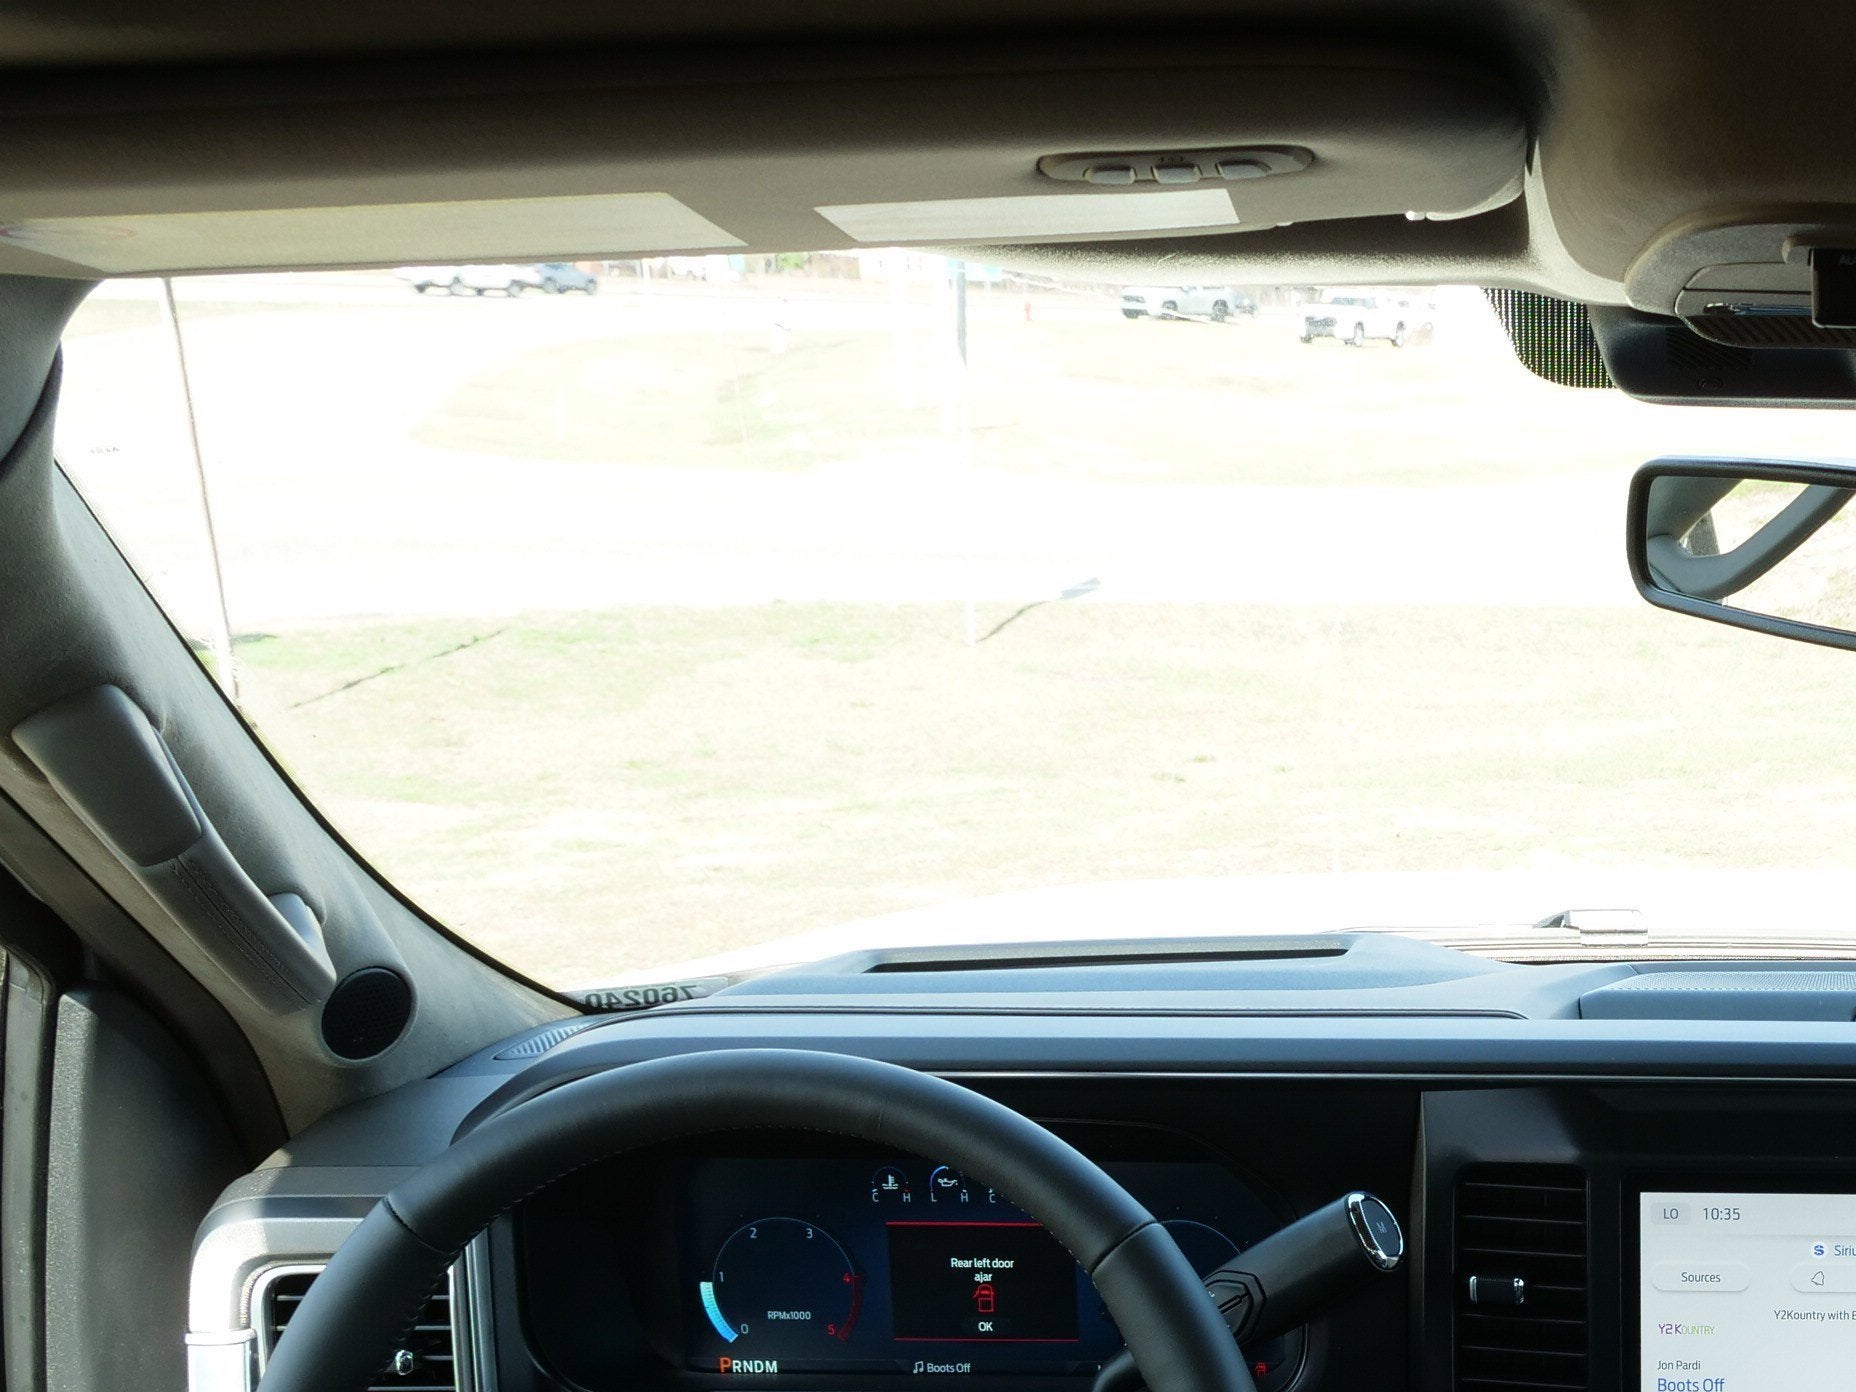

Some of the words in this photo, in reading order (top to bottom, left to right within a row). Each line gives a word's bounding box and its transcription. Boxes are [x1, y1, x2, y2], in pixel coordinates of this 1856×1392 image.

[1662, 1208, 1679, 1220] LO
[1702, 1207, 1741, 1222] 10:35
[750, 1228, 757, 1238] 2
[807, 1228, 813, 1238] 3
[951, 1258, 972, 1268] Rear
[974, 1258, 991, 1268] left
[992, 1258, 1014, 1268] door
[719, 1272, 723, 1281] 1
[843, 1274, 850, 1283] 4
[975, 1272, 992, 1282] ajar
[1681, 1272, 1721, 1284] Sources
[767, 1311, 811, 1320] RPMx1000
[1774, 1310, 1826, 1322] Y2Kountry
[1828, 1310, 1850, 1320] with
[741, 1324, 748, 1334] 0
[828, 1325, 835, 1334] 5
[979, 1322, 993, 1331] OK
[927, 1364, 954, 1372] Boots
[956, 1363, 970, 1372] Off
[1657, 1361, 1673, 1370] Jon
[1676, 1361, 1700, 1370] Pardi
[1658, 1378, 1699, 1392] Boots
[1703, 1378, 1725, 1392] Off
